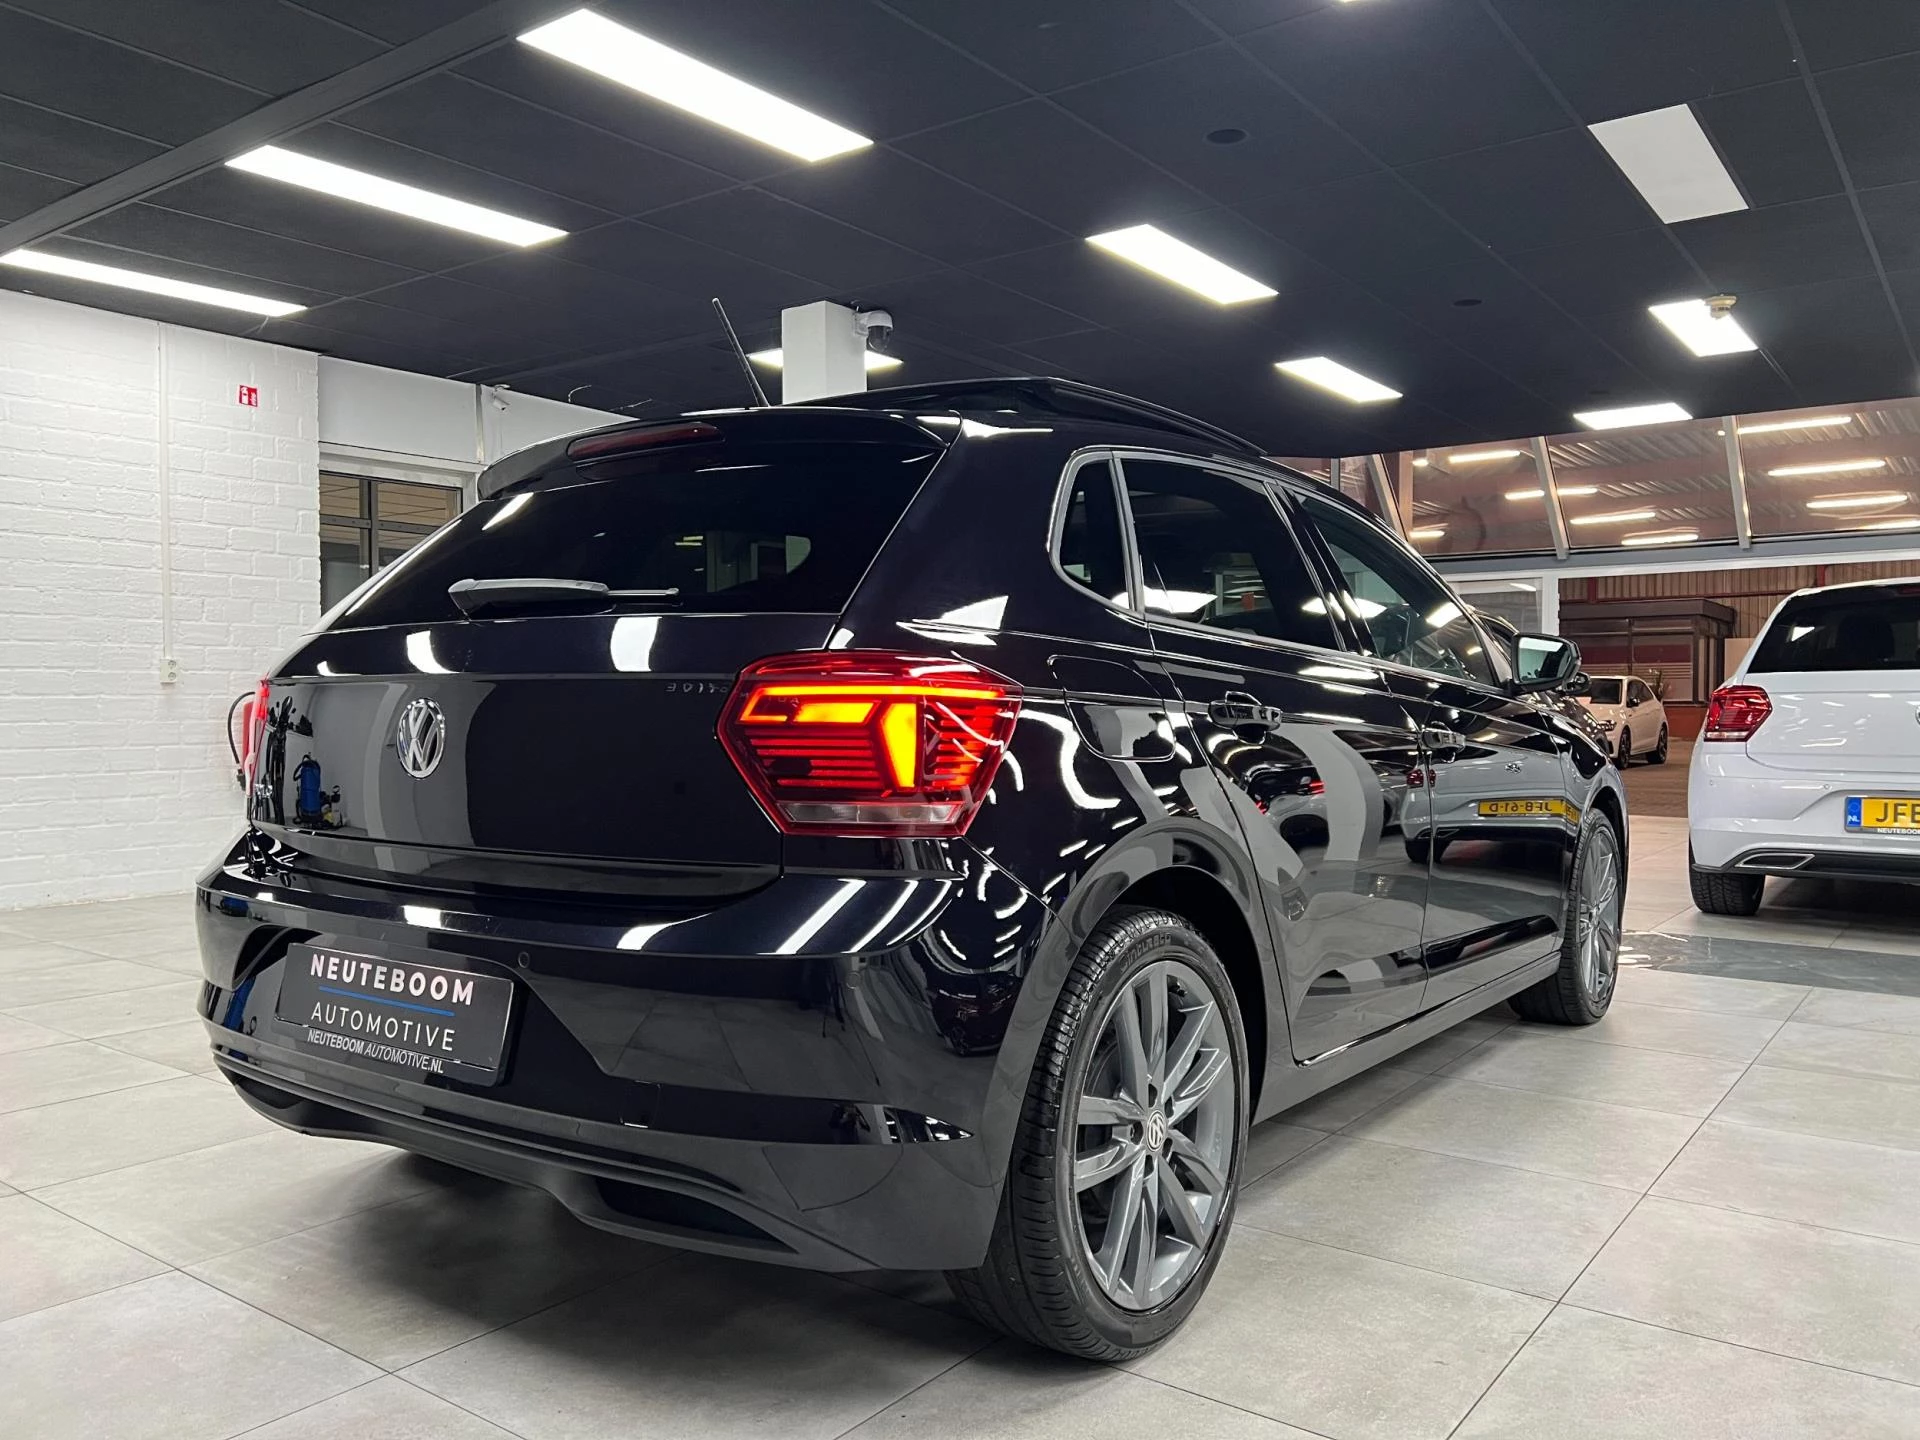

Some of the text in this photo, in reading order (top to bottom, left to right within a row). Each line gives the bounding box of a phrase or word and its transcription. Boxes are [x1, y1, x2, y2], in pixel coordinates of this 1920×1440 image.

[1847, 815, 1860, 823] NL
[310, 954, 474, 1005] NEUTEBOOM
[311, 1002, 456, 1051] AUTOMOTIVE
[307, 1029, 444, 1074] NEUTEBOOM AUTOMOTIVE.NL
